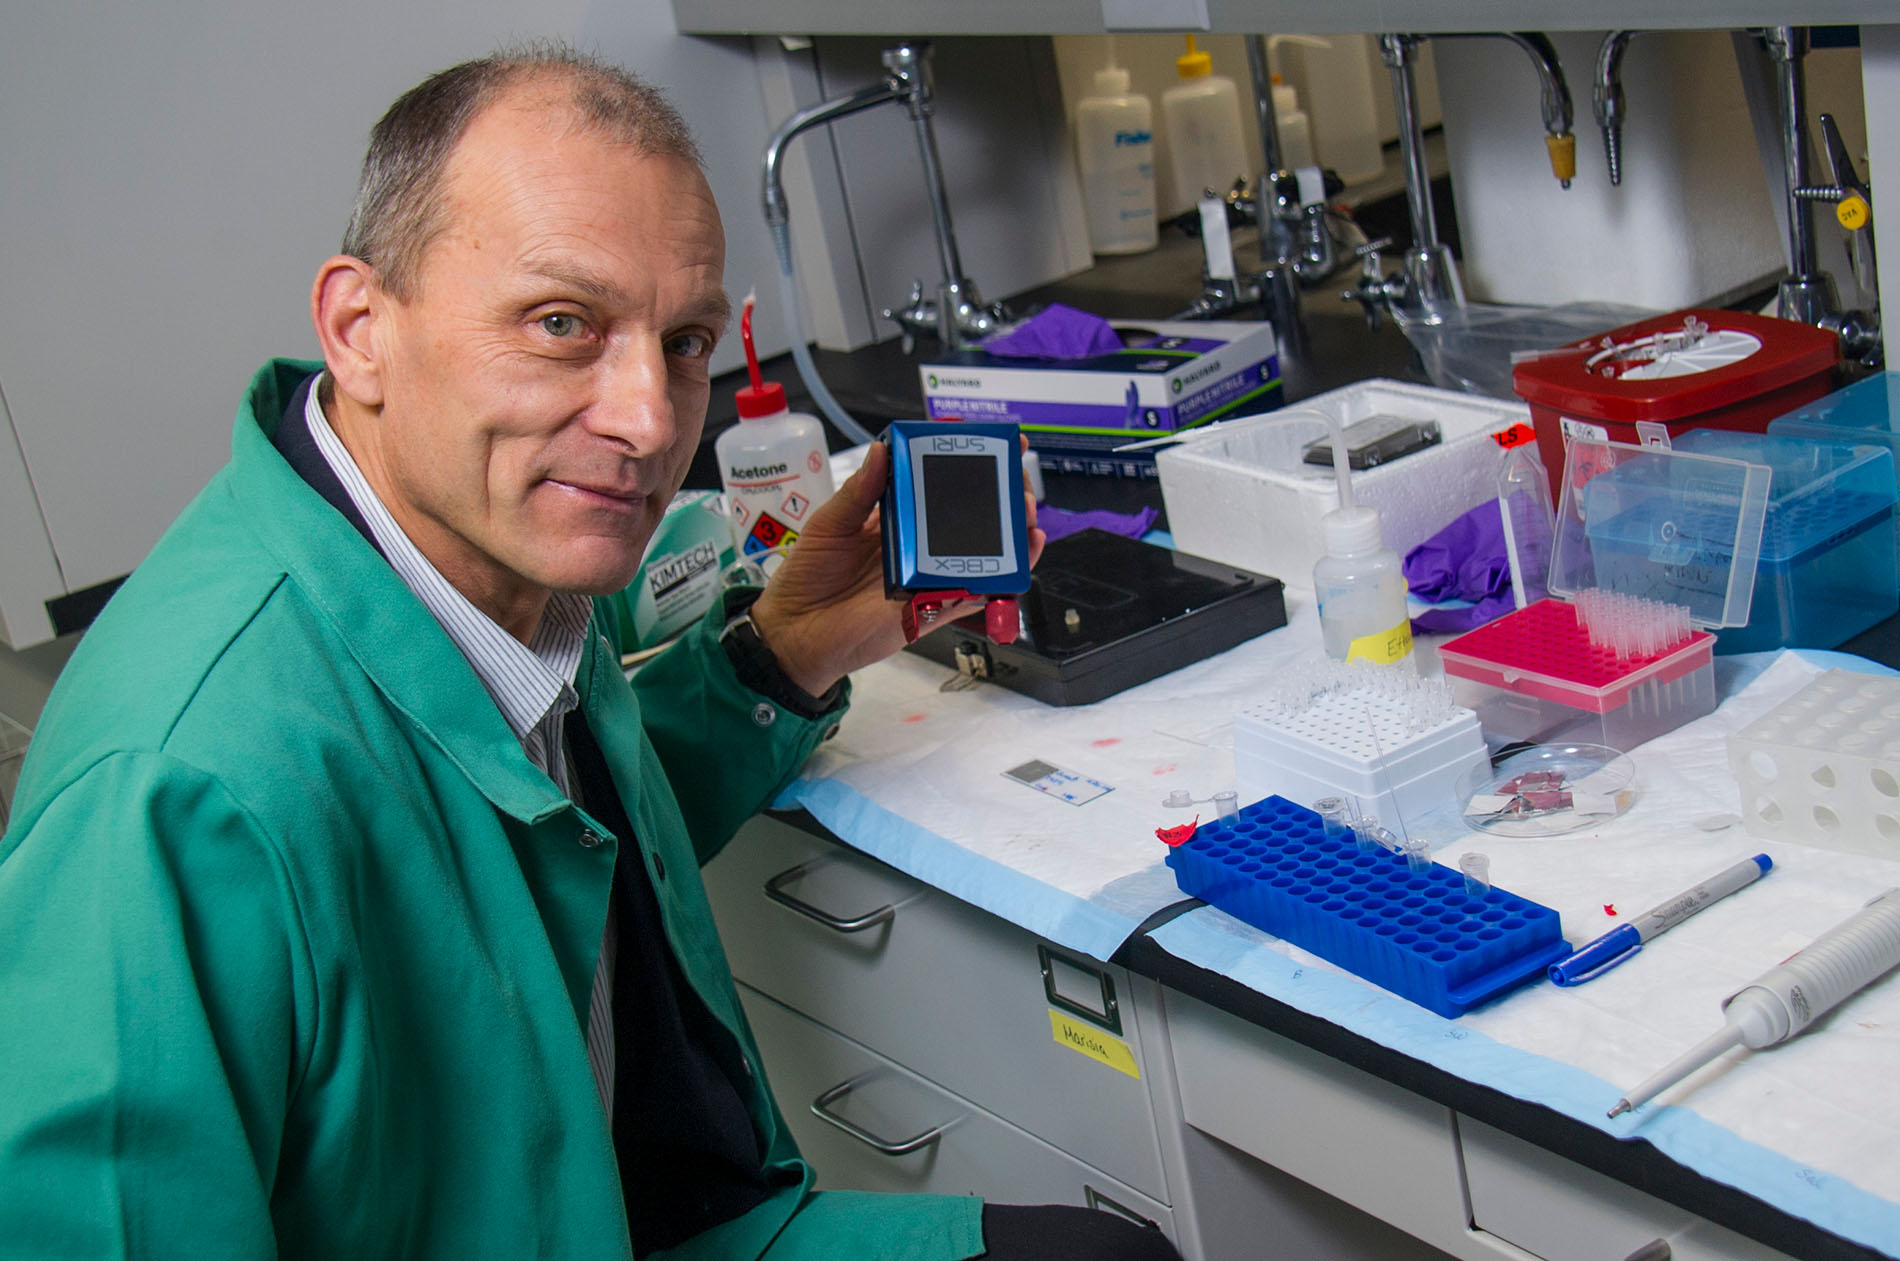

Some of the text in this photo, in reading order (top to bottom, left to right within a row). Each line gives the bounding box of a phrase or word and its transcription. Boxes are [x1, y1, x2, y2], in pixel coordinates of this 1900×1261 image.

[1178, 390, 1212, 414] PURPLE
[1212, 373, 1246, 400] NITRILE
[932, 398, 1008, 414] PURPLE NITRILE
[1146, 408, 1158, 427] S
[731, 463, 788, 480] Acetone
[760, 521, 776, 541] 3
[650, 542, 716, 591] KIMTECH
